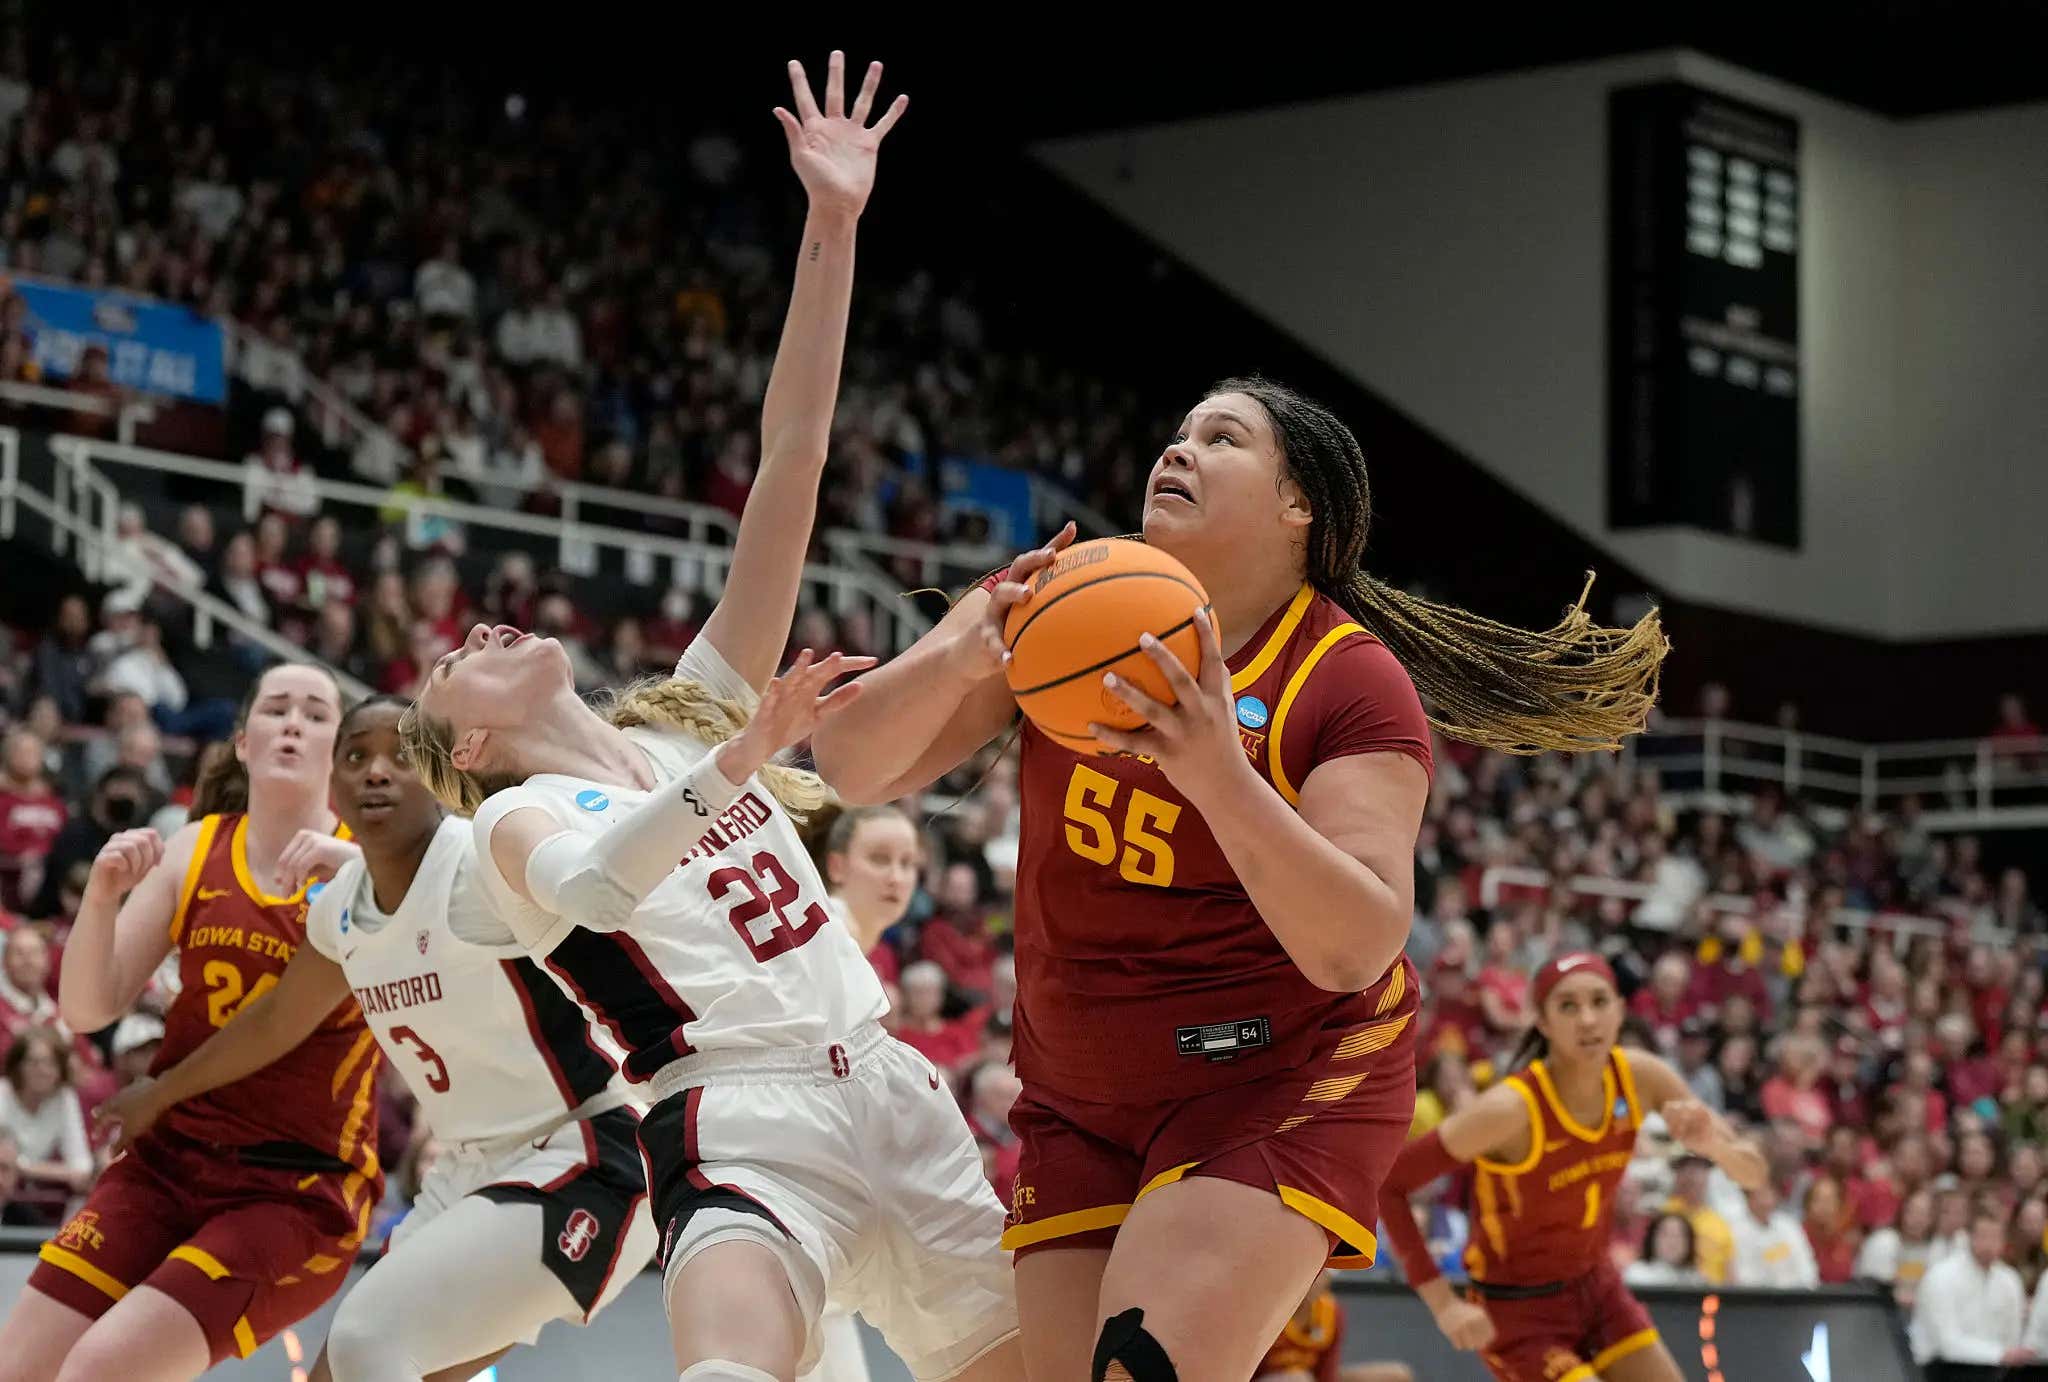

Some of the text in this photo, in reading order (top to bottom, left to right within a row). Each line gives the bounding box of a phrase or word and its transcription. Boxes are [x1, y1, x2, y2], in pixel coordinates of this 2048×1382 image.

[1064, 763, 1182, 887] 55
[707, 851, 830, 963] 22
[188, 926, 243, 949] IOWA
[354, 972, 442, 1015] TANFORD
[1242, 1026, 1257, 1040] 54
[389, 1025, 450, 1093] 3
[1582, 1182, 1600, 1229] 1
